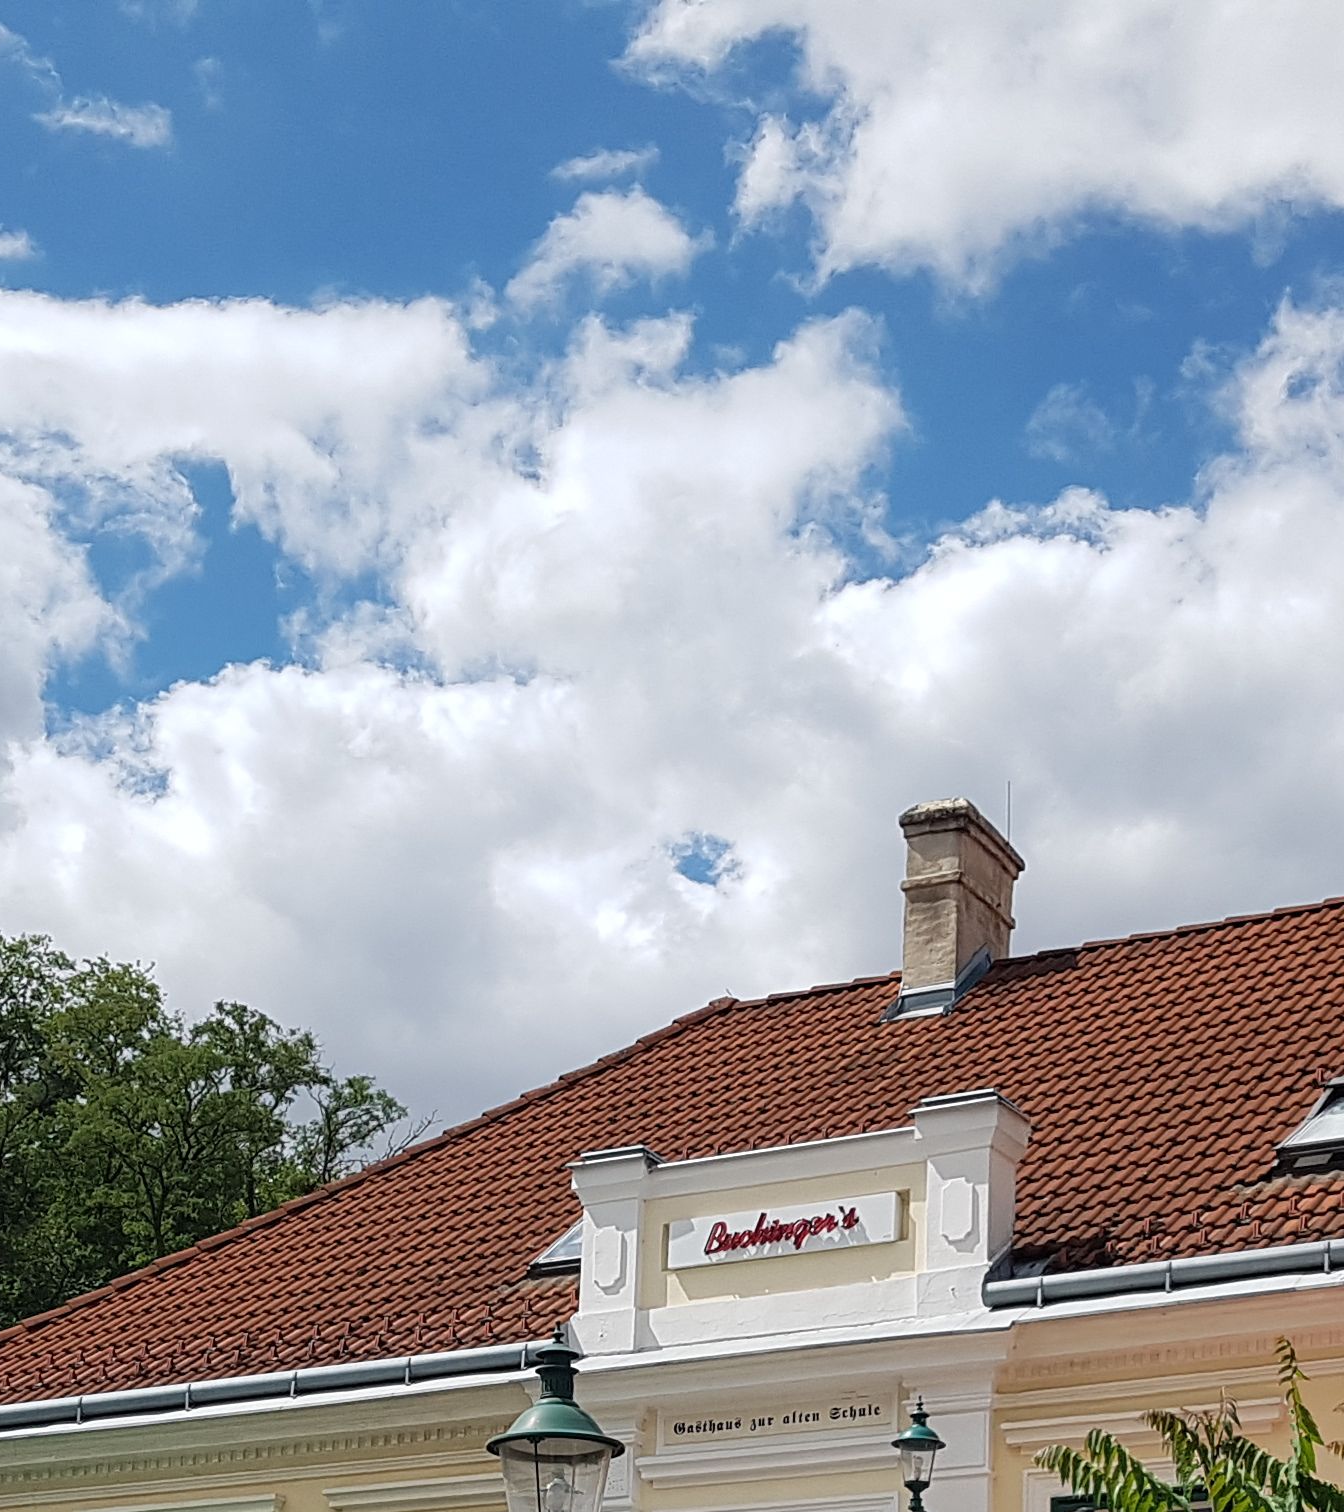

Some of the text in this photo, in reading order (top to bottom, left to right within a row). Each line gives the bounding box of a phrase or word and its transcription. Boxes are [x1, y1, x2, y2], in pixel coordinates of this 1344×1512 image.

[673, 1404, 882, 1435] Gasthaus zur alten Schule
